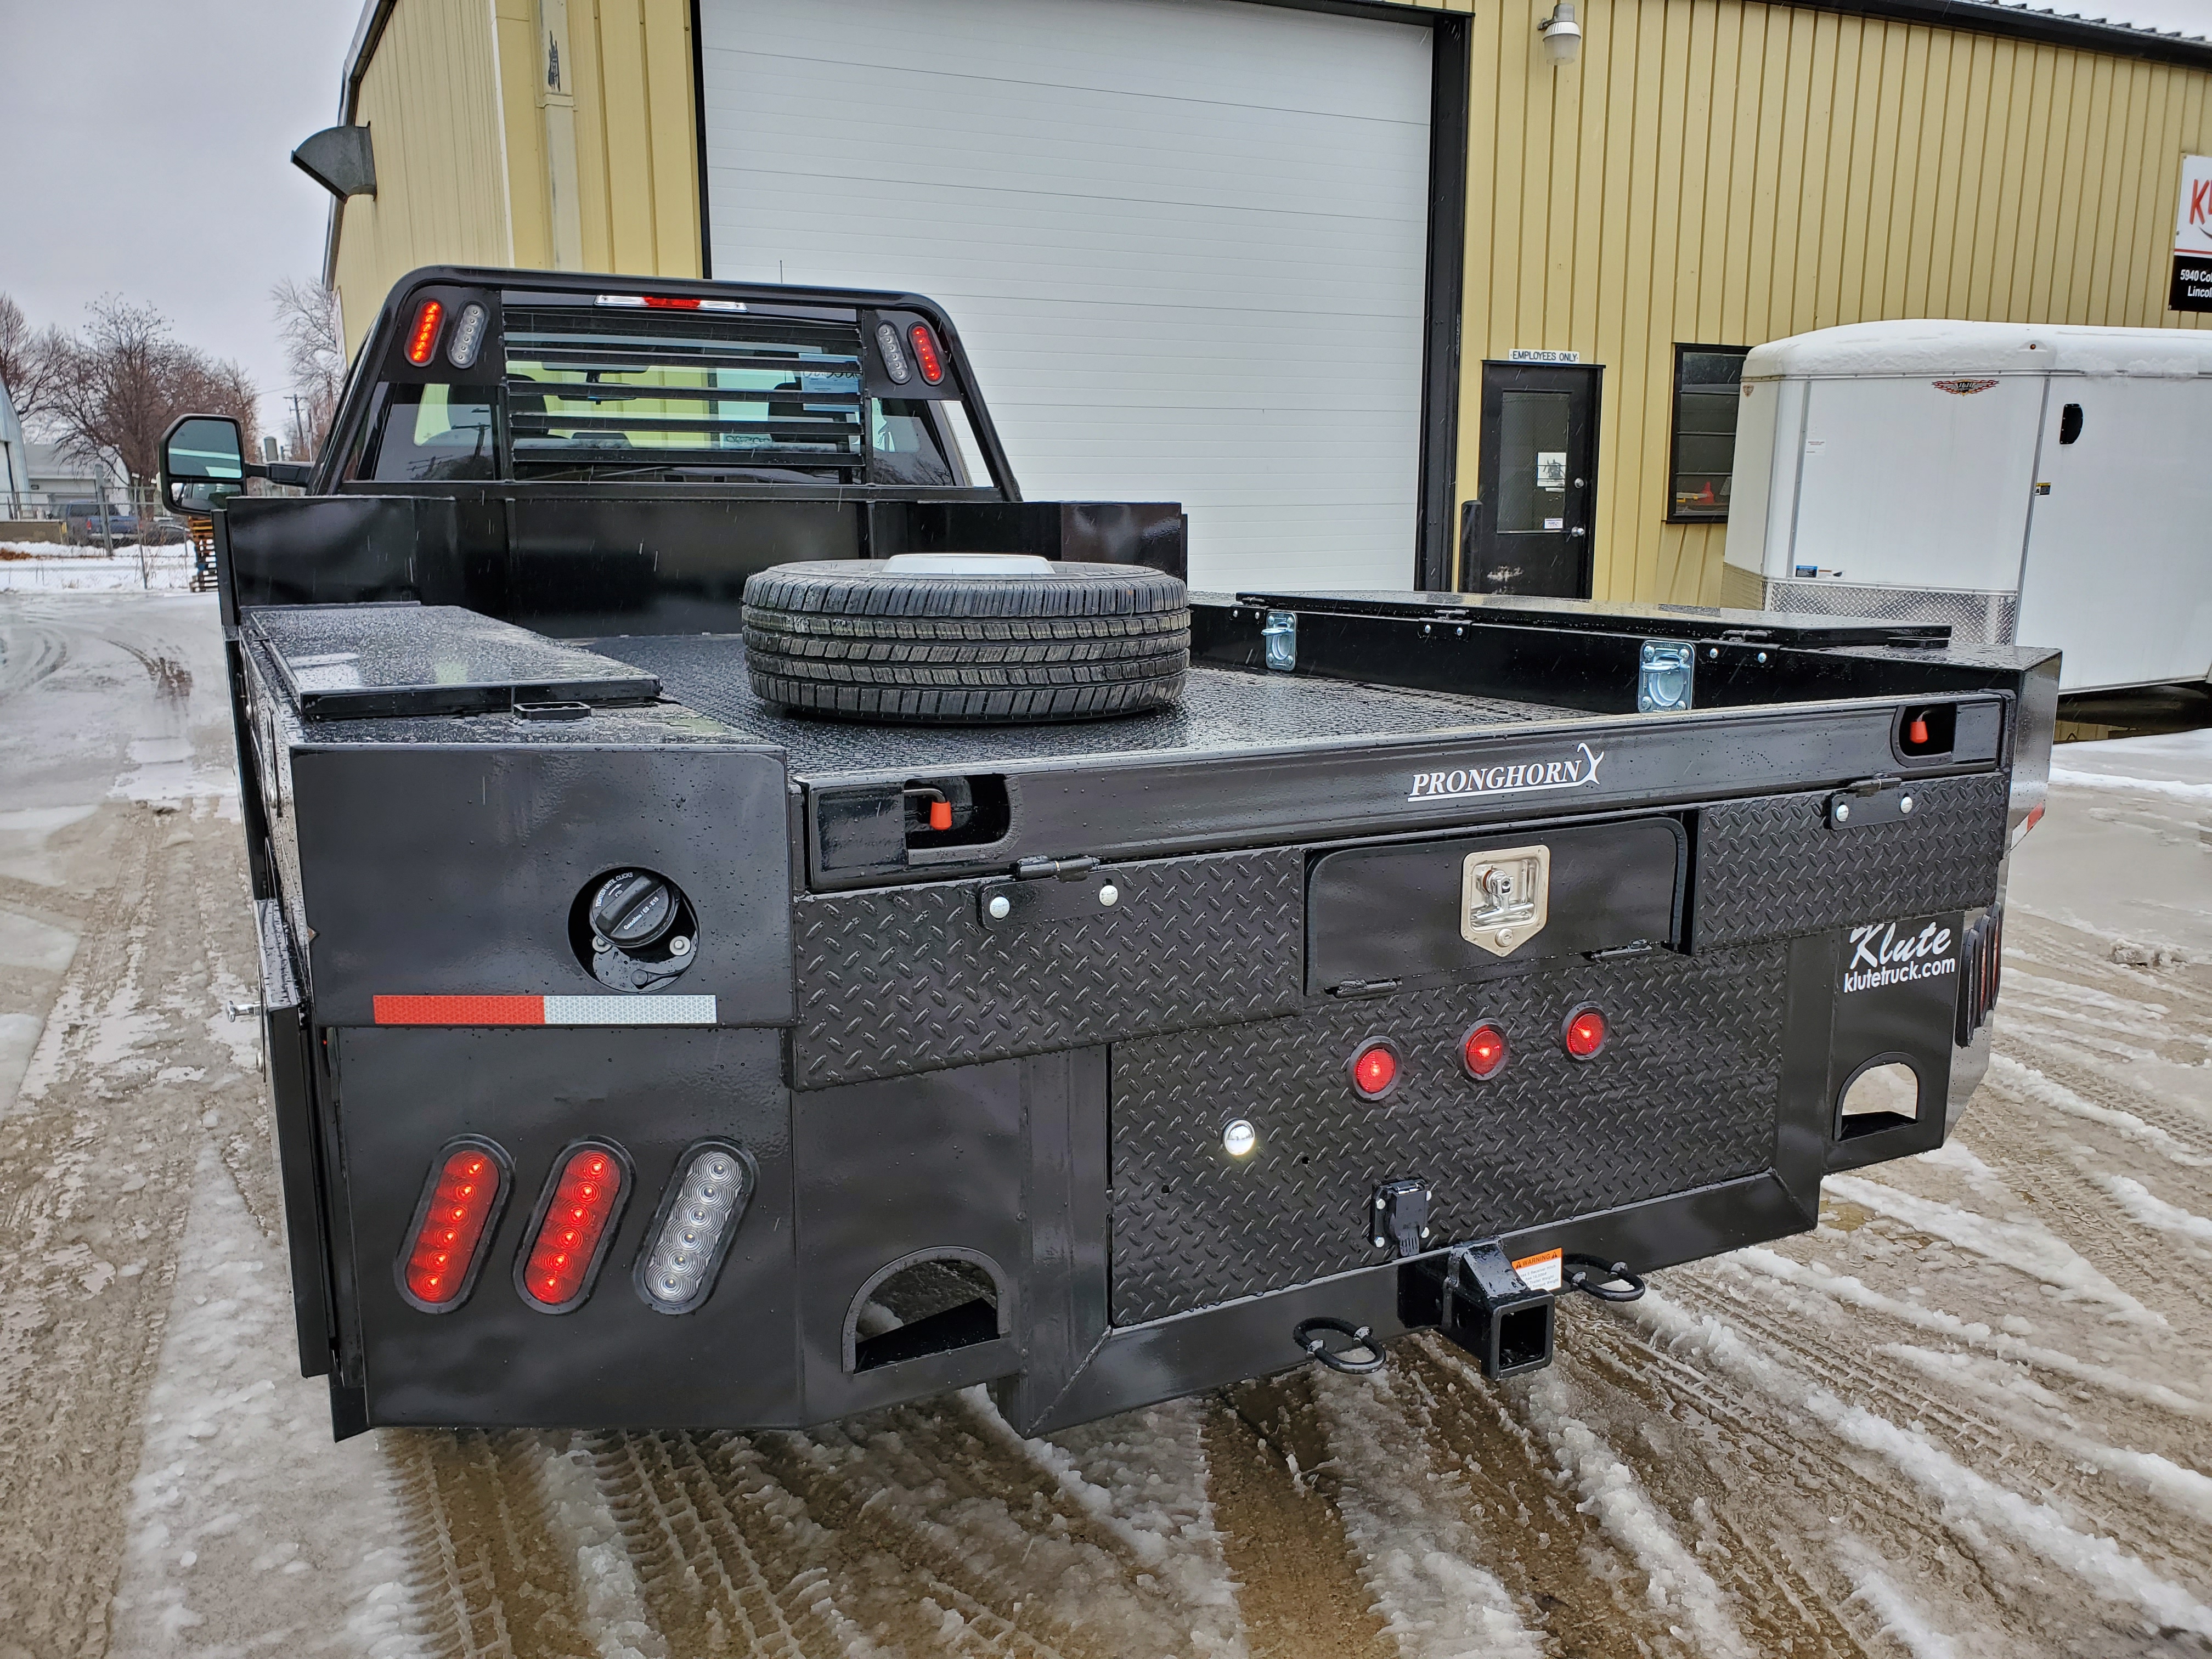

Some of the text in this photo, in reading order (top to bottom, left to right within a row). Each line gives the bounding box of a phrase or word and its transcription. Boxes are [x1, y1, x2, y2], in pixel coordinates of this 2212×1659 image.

[2180, 269, 2199, 281] 5940
[1513, 351, 1577, 362] EMPLOYEES ONLY
[595, 872, 633, 907] TIGHTEN UNTIL CLICKS
[623, 913, 642, 930] Gasoline
[650, 896, 659, 906] E15
[1849, 922, 1951, 970] Klute
[1844, 958, 1955, 993] klutetruck.com
[1522, 1254, 1550, 1266] WARNING
